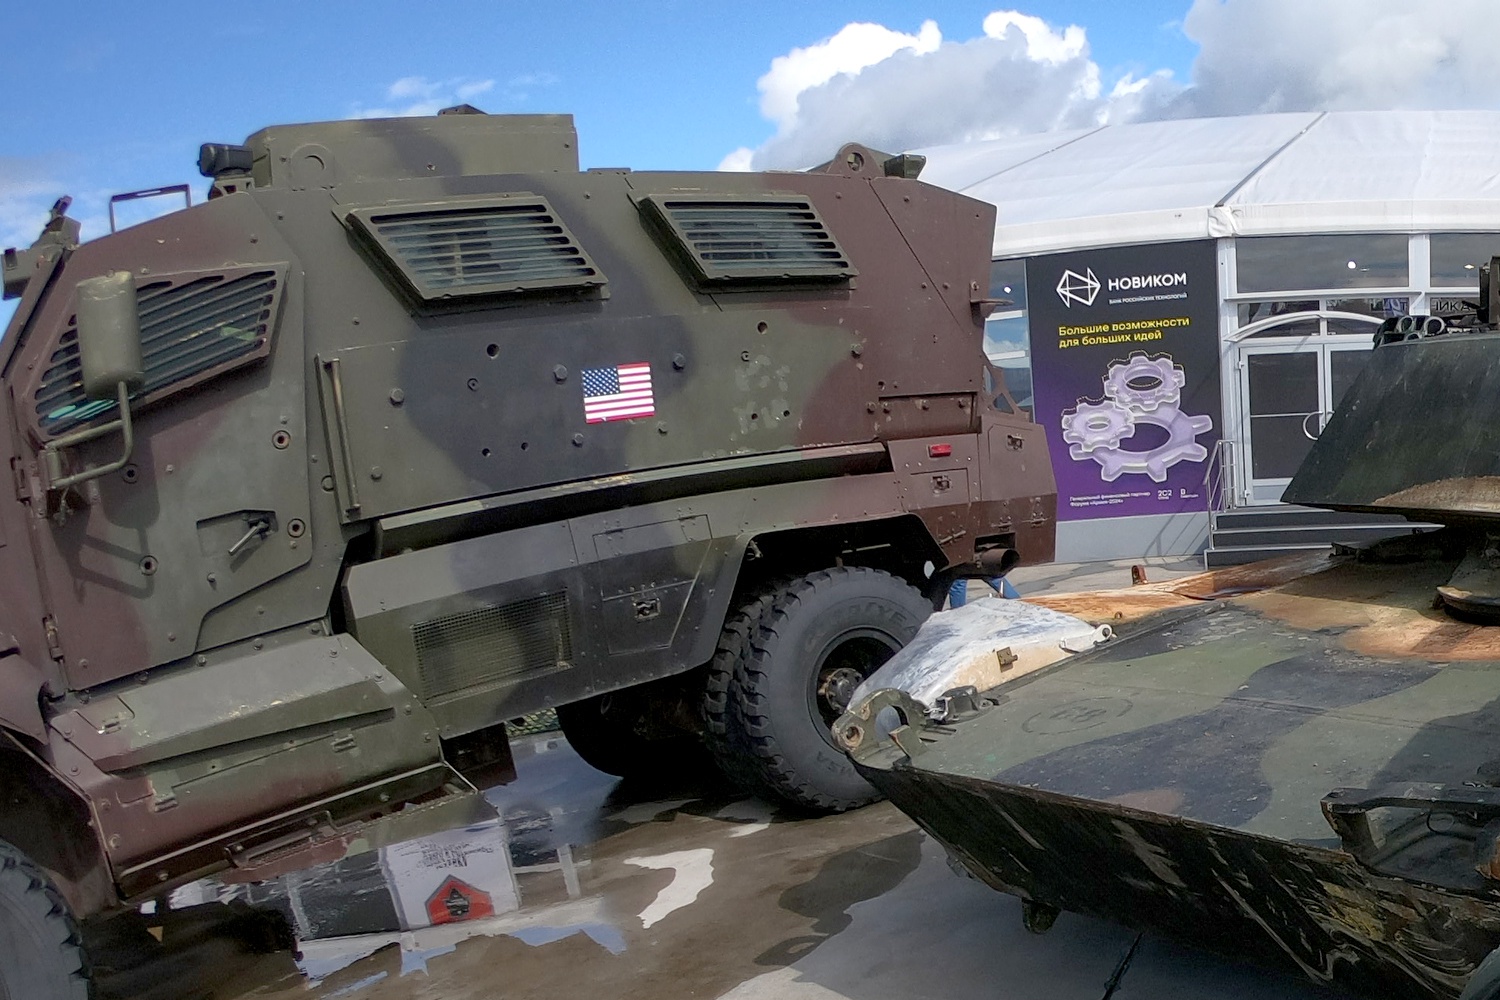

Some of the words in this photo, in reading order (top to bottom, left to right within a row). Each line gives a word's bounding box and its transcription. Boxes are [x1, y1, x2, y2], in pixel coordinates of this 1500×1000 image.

[1108, 272, 1187, 291] НОВИКОМ
[1058, 322, 1110, 337] Большие
[1112, 317, 1190, 332] возможности
[1059, 338, 1080, 349] для
[1082, 332, 1131, 346] больших
[1133, 329, 1162, 342] идей
